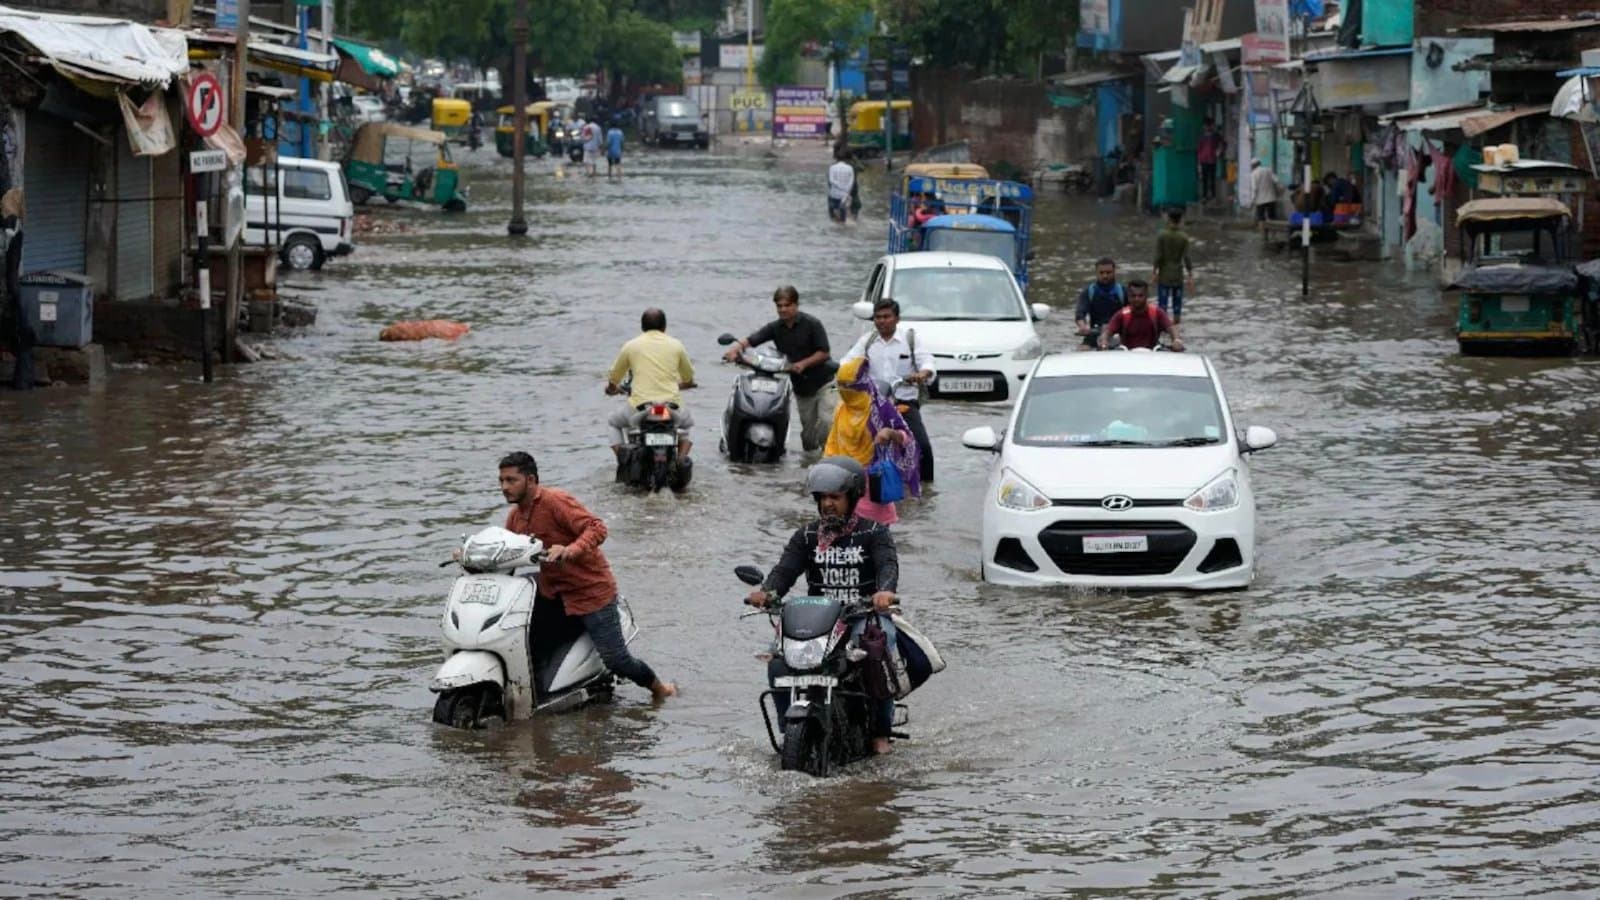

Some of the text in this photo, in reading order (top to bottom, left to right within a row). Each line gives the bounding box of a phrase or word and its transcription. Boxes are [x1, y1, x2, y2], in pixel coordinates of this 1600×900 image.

[733, 96, 763, 108] PUC
[814, 545, 864, 565] BREAK
[819, 568, 860, 586] YOUR
